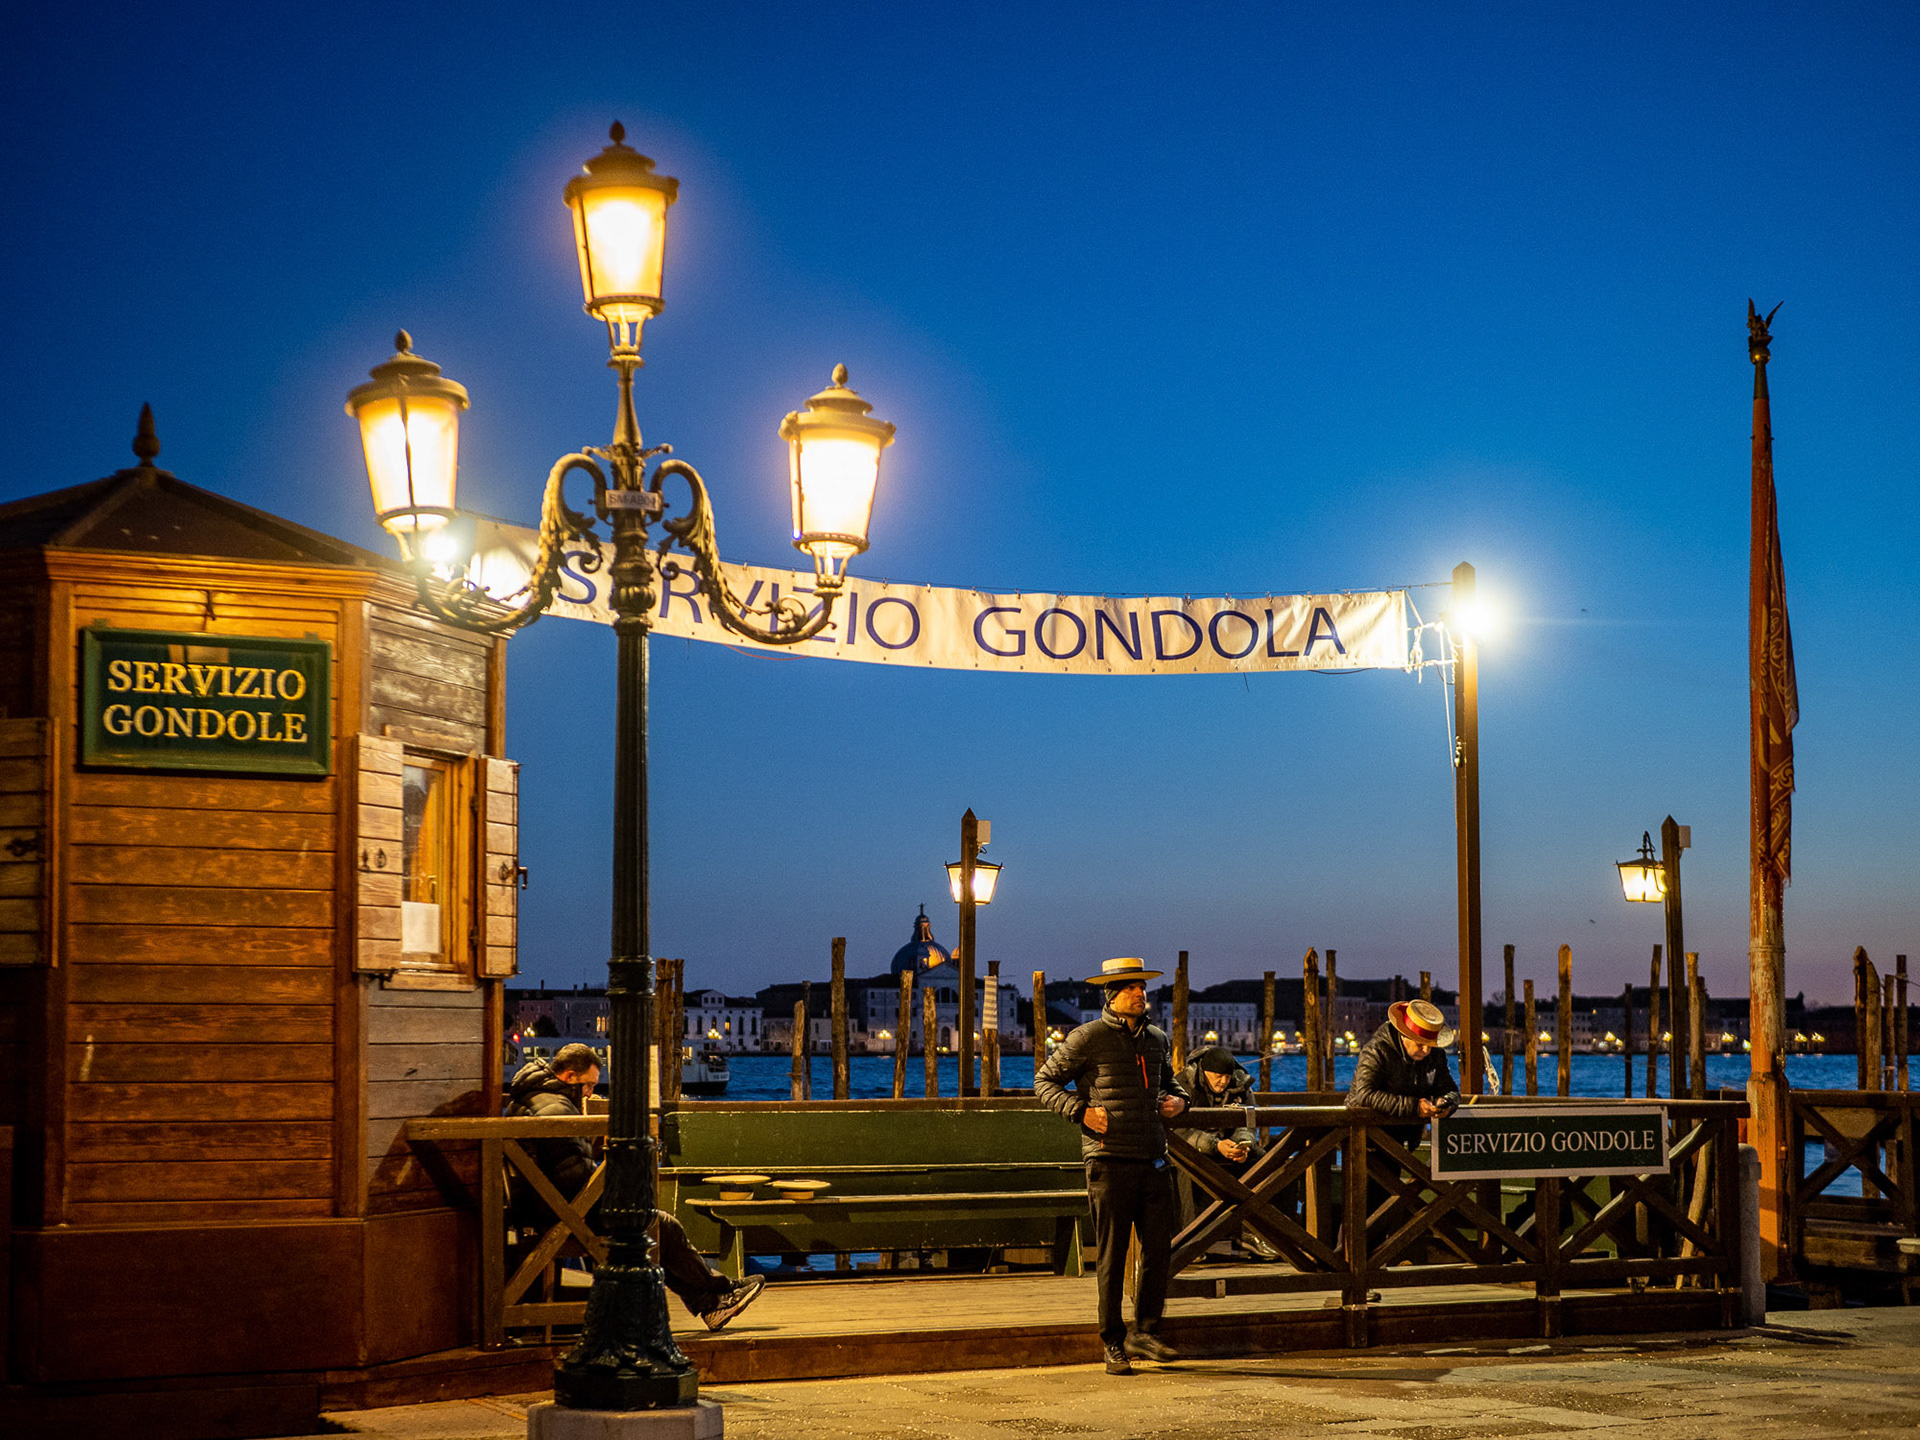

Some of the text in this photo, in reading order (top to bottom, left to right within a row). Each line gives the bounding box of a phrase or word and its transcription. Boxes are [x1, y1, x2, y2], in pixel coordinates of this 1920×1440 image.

[557, 550, 1347, 661] SRIZIO GONDOLA
[107, 659, 307, 701] SERVIZIO
[102, 703, 308, 743] GONDOLE
[1446, 1129, 1656, 1155] SERVIZIO GONDOLE
